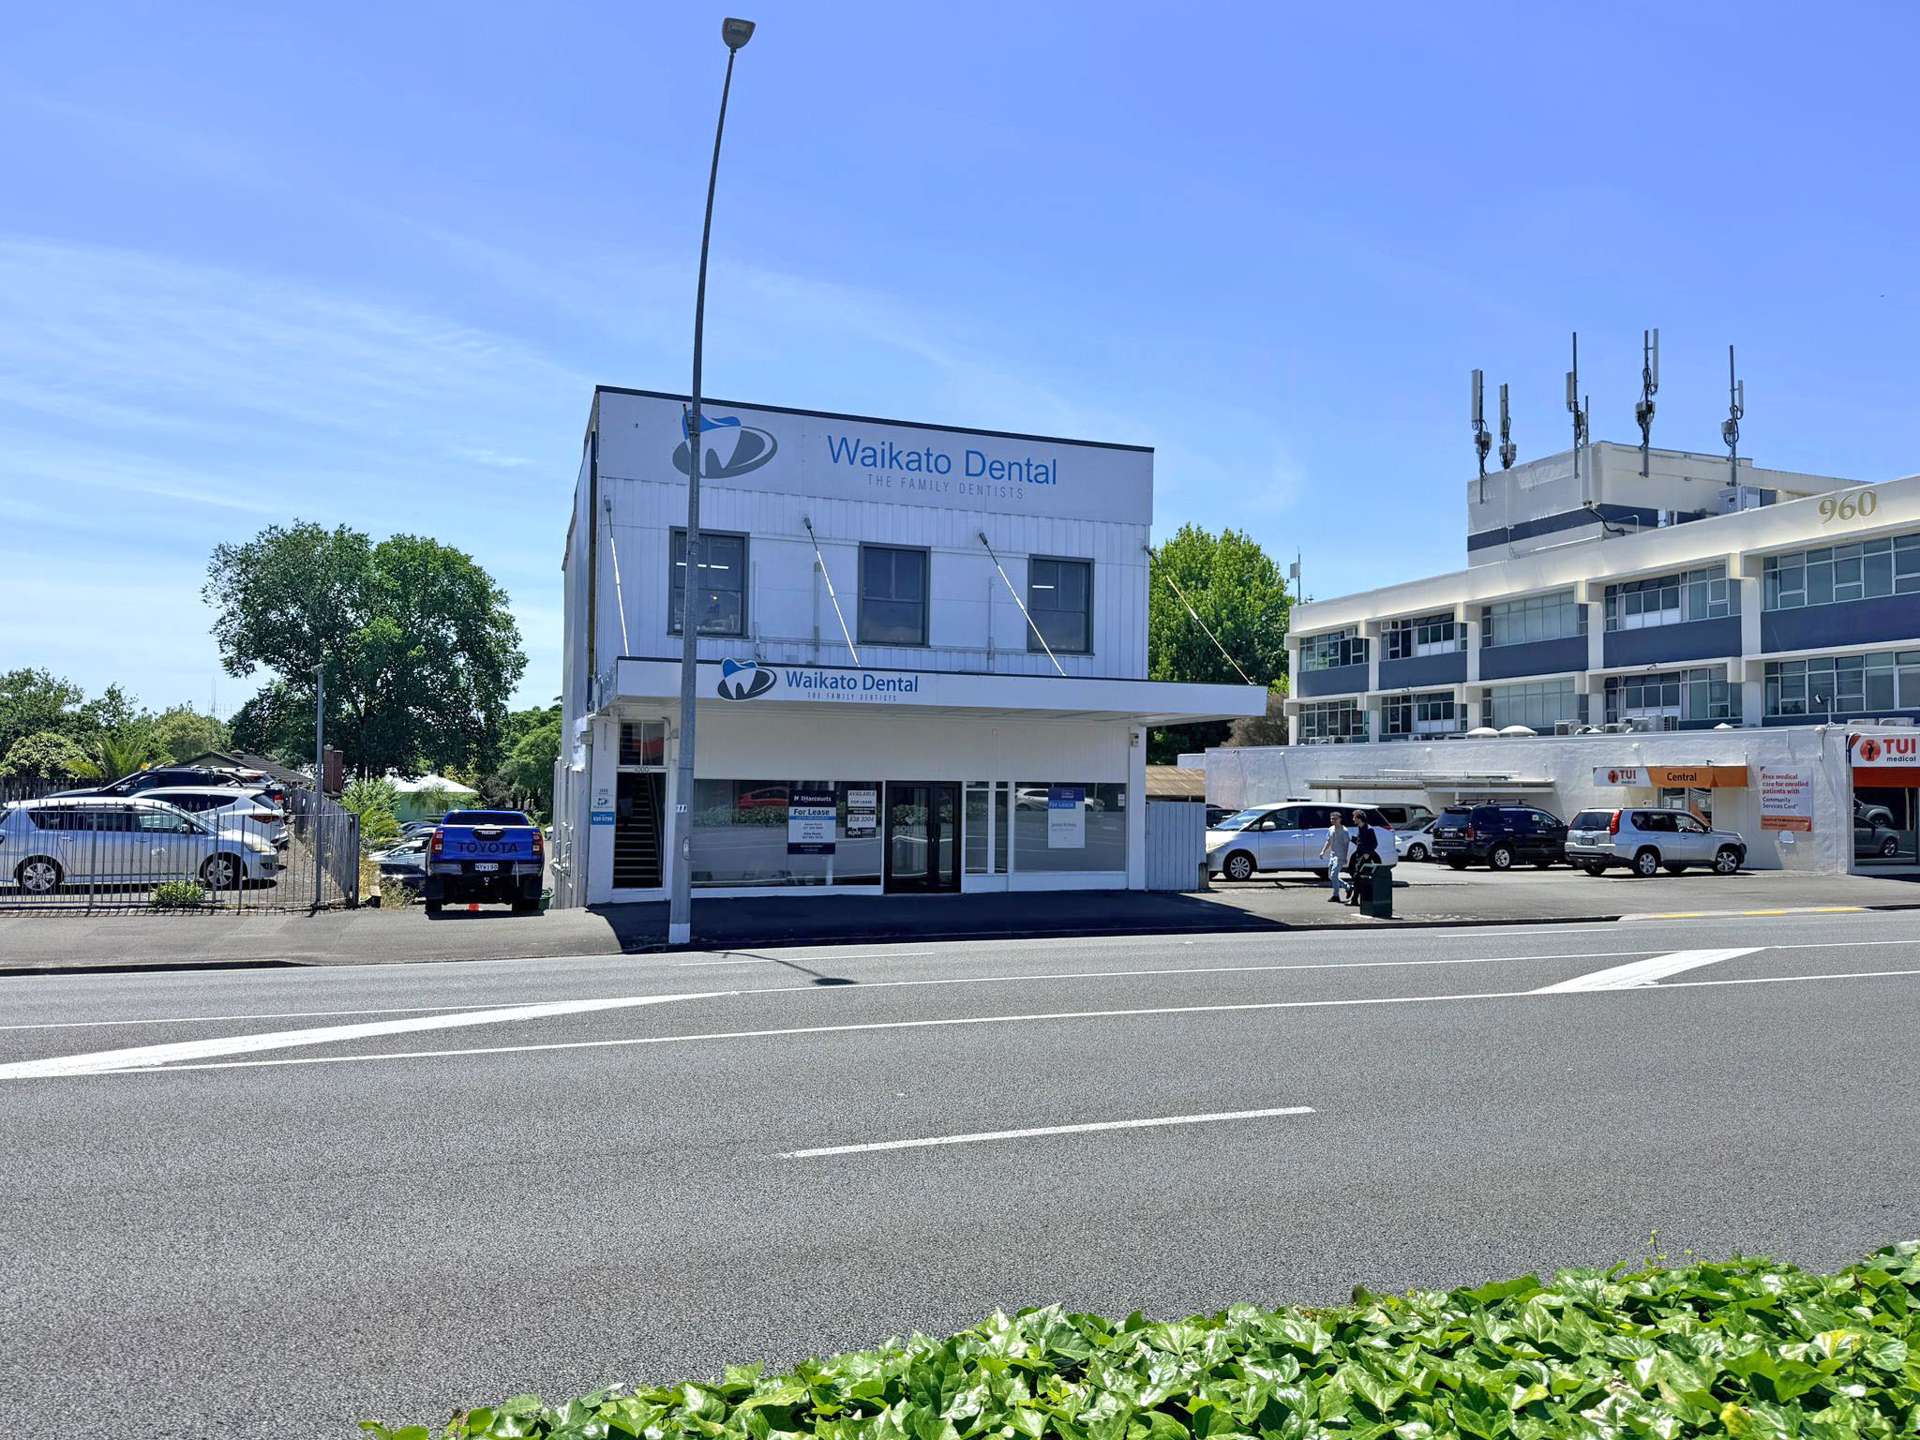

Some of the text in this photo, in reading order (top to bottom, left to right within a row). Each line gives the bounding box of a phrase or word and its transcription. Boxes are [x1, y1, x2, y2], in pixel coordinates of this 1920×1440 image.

[827, 435, 1057, 485] Waikato Dental
[867, 473, 1024, 499] THE FAMILY DENTISTS
[1819, 491, 1877, 524] 960
[786, 671, 919, 693] Waikato Dental
[1883, 738, 1916, 754] TUI
[1887, 755, 1916, 763] medical
[1620, 770, 1636, 779] TUI
[1666, 772, 1697, 782] Central
[456, 842, 518, 853] TOYOTA
